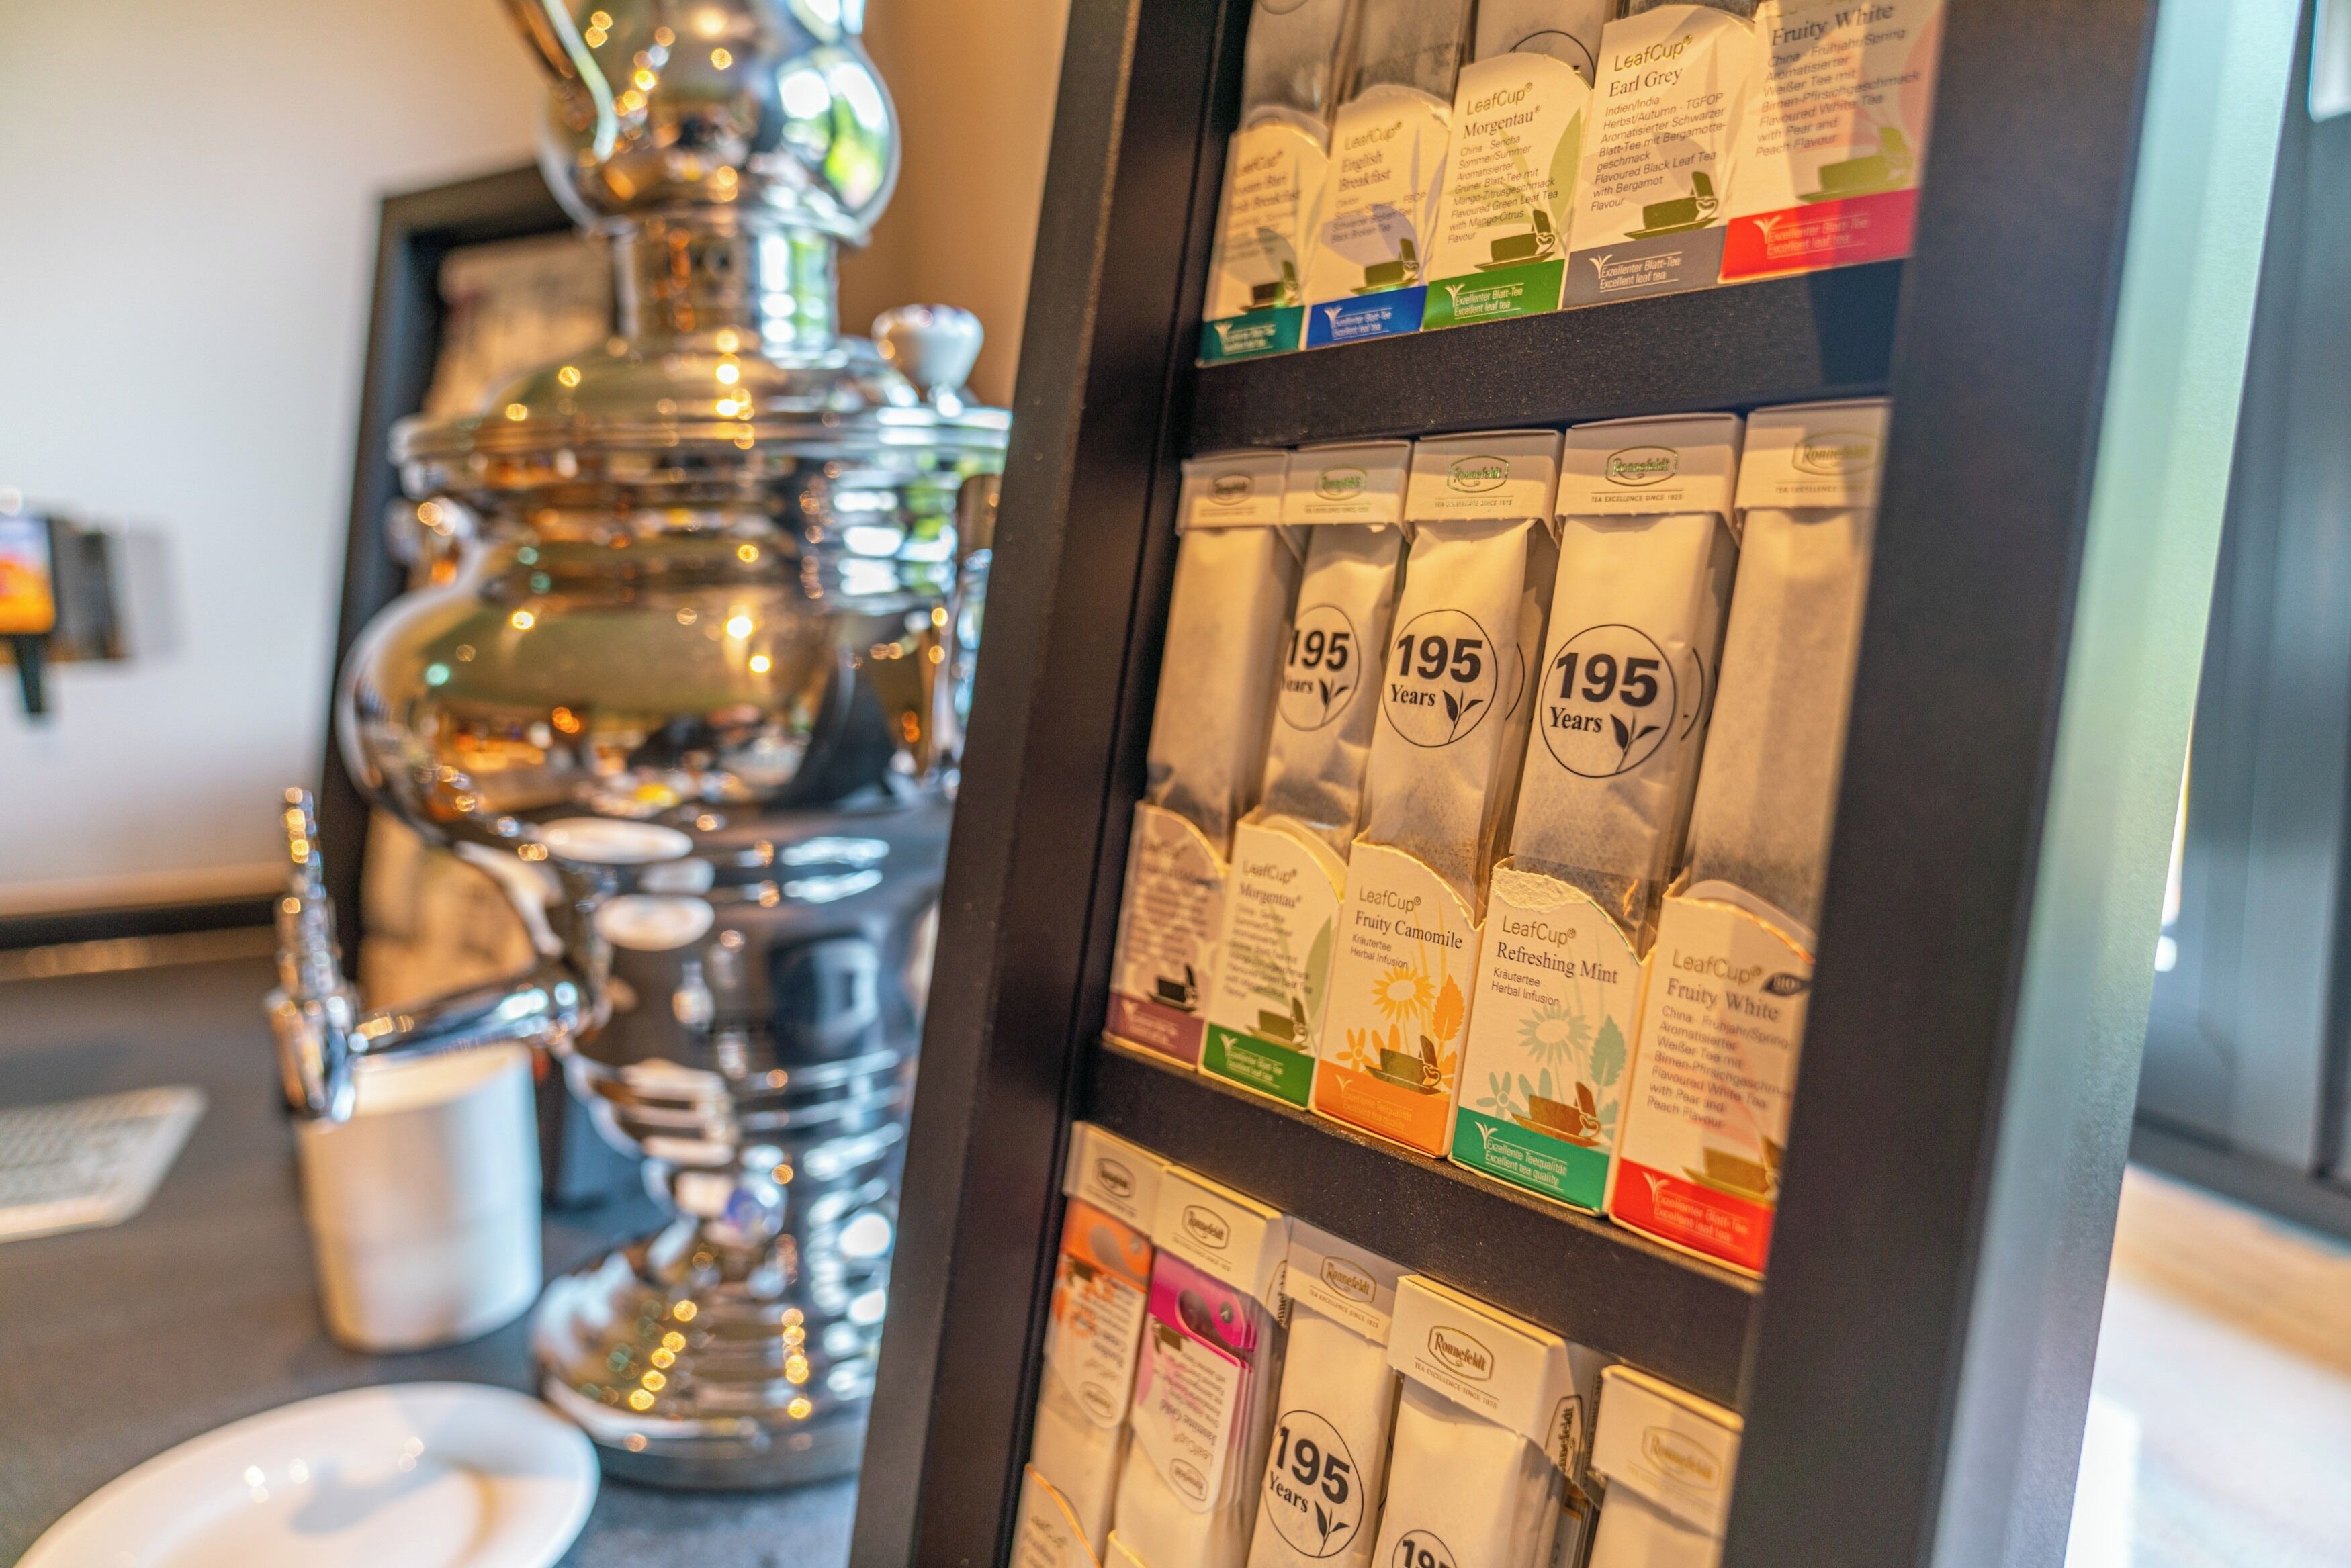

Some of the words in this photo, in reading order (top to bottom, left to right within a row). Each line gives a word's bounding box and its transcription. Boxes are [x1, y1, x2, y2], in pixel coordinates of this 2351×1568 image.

[1771, 21, 1827, 46] Fruity
[1835, 5, 1894, 29] White
[1765, 56, 1850, 83] Aromatisierter
[1768, 52, 1800, 68] China
[1609, 75, 1640, 97] Earl
[1644, 68, 1683, 87] Grey
[1836, 68, 1856, 82] mit
[1603, 105, 1676, 130] Herbst/Autumn
[1686, 93, 1724, 109] TGFOP
[1605, 97, 1660, 117] Indien/India
[1759, 107, 1816, 127] Flavoured
[1820, 99, 1856, 115] White
[1601, 122, 1669, 144] Aromatisierter
[1672, 107, 1725, 128] Schwarzer
[1757, 129, 1782, 142] with
[1786, 123, 1812, 136] Pear
[1815, 118, 1838, 128] and
[1460, 145, 1482, 156] China
[1490, 136, 1520, 149] Sencha
[1599, 142, 1641, 158] Blatt-Tee
[1644, 134, 1660, 147] mit
[1663, 122, 1726, 144] Bergamotte-
[1793, 134, 1837, 150] Flavour
[1342, 150, 1382, 173] English
[1458, 145, 1532, 169] Sommer/Summer
[1595, 168, 1641, 185] Flavoured
[1643, 160, 1669, 175] Black
[1673, 155, 1695, 168] Leaf
[1698, 151, 1716, 163] Tea
[1597, 151, 1650, 173] geschmack
[1339, 169, 1390, 192] Breakfast
[1457, 162, 1515, 181] Aromatisierter
[1484, 173, 1521, 187] Blatt-Tee
[1524, 169, 1538, 179] mit
[1453, 177, 1554, 207] Mango-Zitrusgeschmack
[1593, 186, 1613, 197] with
[1615, 175, 1663, 193] Bergamot
[1451, 204, 1489, 219] Flavoured
[1493, 199, 1517, 210] Green
[1520, 193, 1539, 205] Leaf
[1544, 191, 1558, 200] Tea
[1591, 197, 1624, 212] Flavour
[1449, 221, 1466, 232] with
[1469, 210, 1524, 227] Mango-Citrus
[1448, 232, 1476, 244] Flavour
[1601, 262, 1642, 278] Exzellenter
[1644, 255, 1681, 270] Blatt-Tee
[1493, 287, 1523, 299] Blatt-Tee
[1601, 275, 1634, 289] Excellent
[1636, 272, 1650, 283] leaf
[1654, 271, 1666, 280] tea
[1454, 304, 1483, 317] Excellent
[1485, 302, 1497, 312] leaf
[1500, 300, 1511, 309] tea
[1288, 629, 1350, 672] 195
[1396, 635, 1483, 683] 195
[1556, 652, 1660, 707] 195
[1390, 684, 1436, 706] Years
[1550, 706, 1603, 733] Years
[1355, 910, 1392, 935] Fruity
[1395, 920, 1462, 949] Camomile
[1351, 946, 1374, 960] Herbal
[1377, 954, 1408, 968] Infusion
[1496, 941, 1575, 978] Refreshing
[1581, 960, 1618, 984] Mint
[1493, 967, 1540, 987] Kräutertee
[1773, 976, 1795, 990] BIO
[1491, 980, 1520, 997] Herbal
[1523, 988, 1559, 1006] Infusion
[1667, 977, 1718, 1009] Fruity
[1726, 990, 1779, 1021] White
[1662, 1005, 1693, 1023] China
[1659, 1021, 1736, 1050] Aromatisierter
[1724, 1056, 1744, 1068] mit
[1652, 1065, 1704, 1090] Flavoured
[1707, 1084, 1741, 1101] White
[1649, 1082, 1672, 1096] with
[1676, 1089, 1700, 1104] Pear
[1703, 1099, 1724, 1112] and
[1647, 1095, 1679, 1114] Peach
[1683, 1105, 1723, 1127] Flavour
[1487, 1138, 1523, 1160] Exzellente
[1486, 1150, 1518, 1170] Excellent
[1519, 1164, 1532, 1176] tea
[1533, 1170, 1559, 1187] quality
[1327, 1262, 1370, 1295] Ronnefeldt
[1319, 1295, 1347, 1313] EXCELLENCE
[1349, 1310, 1364, 1321] SINCE
[1435, 1332, 1487, 1371] Ronnefeldt
[1415, 1362, 1425, 1372] TEA
[1427, 1368, 1462, 1391] EXCELLENCE
[1463, 1388, 1480, 1401] SINCE
[1558, 1406, 1574, 1473] nnefeldt
[1276, 1426, 1350, 1504] 195
[1270, 1471, 1308, 1512] Years
[1403, 1539, 1451, 1568] 19
